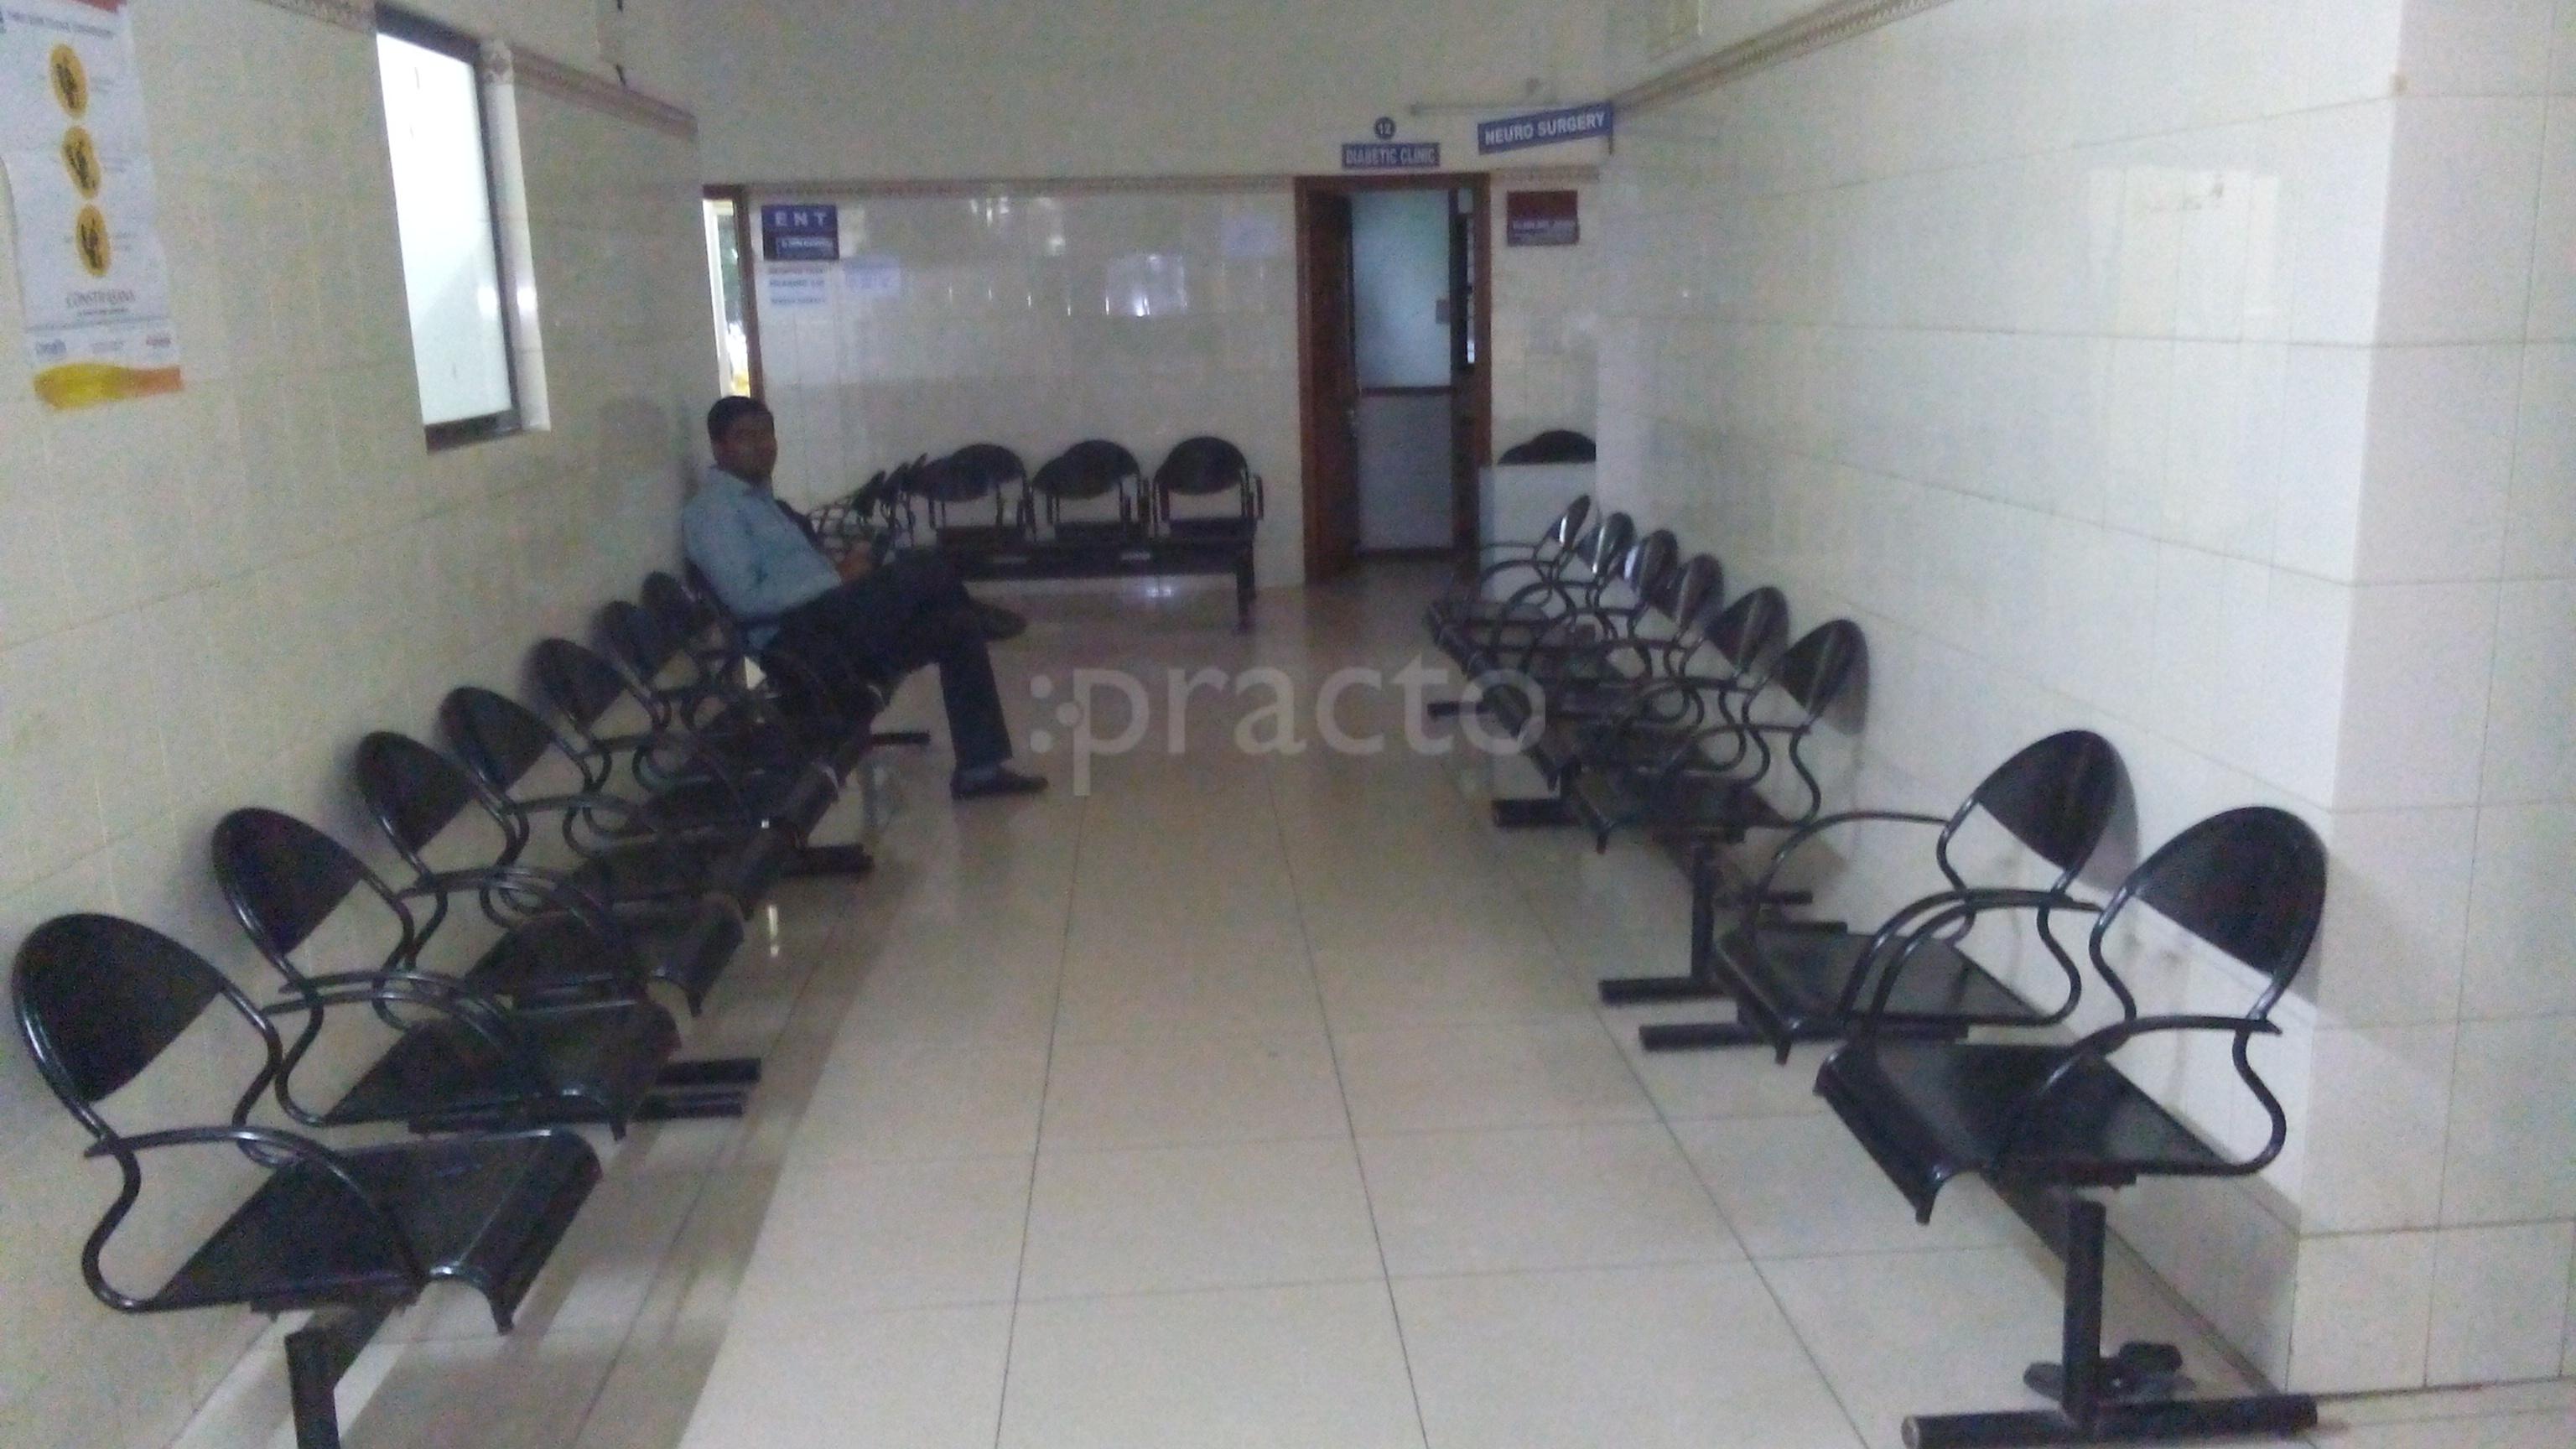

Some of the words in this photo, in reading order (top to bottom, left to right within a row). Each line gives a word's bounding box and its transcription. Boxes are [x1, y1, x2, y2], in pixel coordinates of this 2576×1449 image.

[1484, 123, 1534, 146] NEURO
[1537, 112, 1606, 137] SURGERY
[1346, 147, 1398, 165] DIABETIC
[1400, 147, 1436, 166] CLINIC
